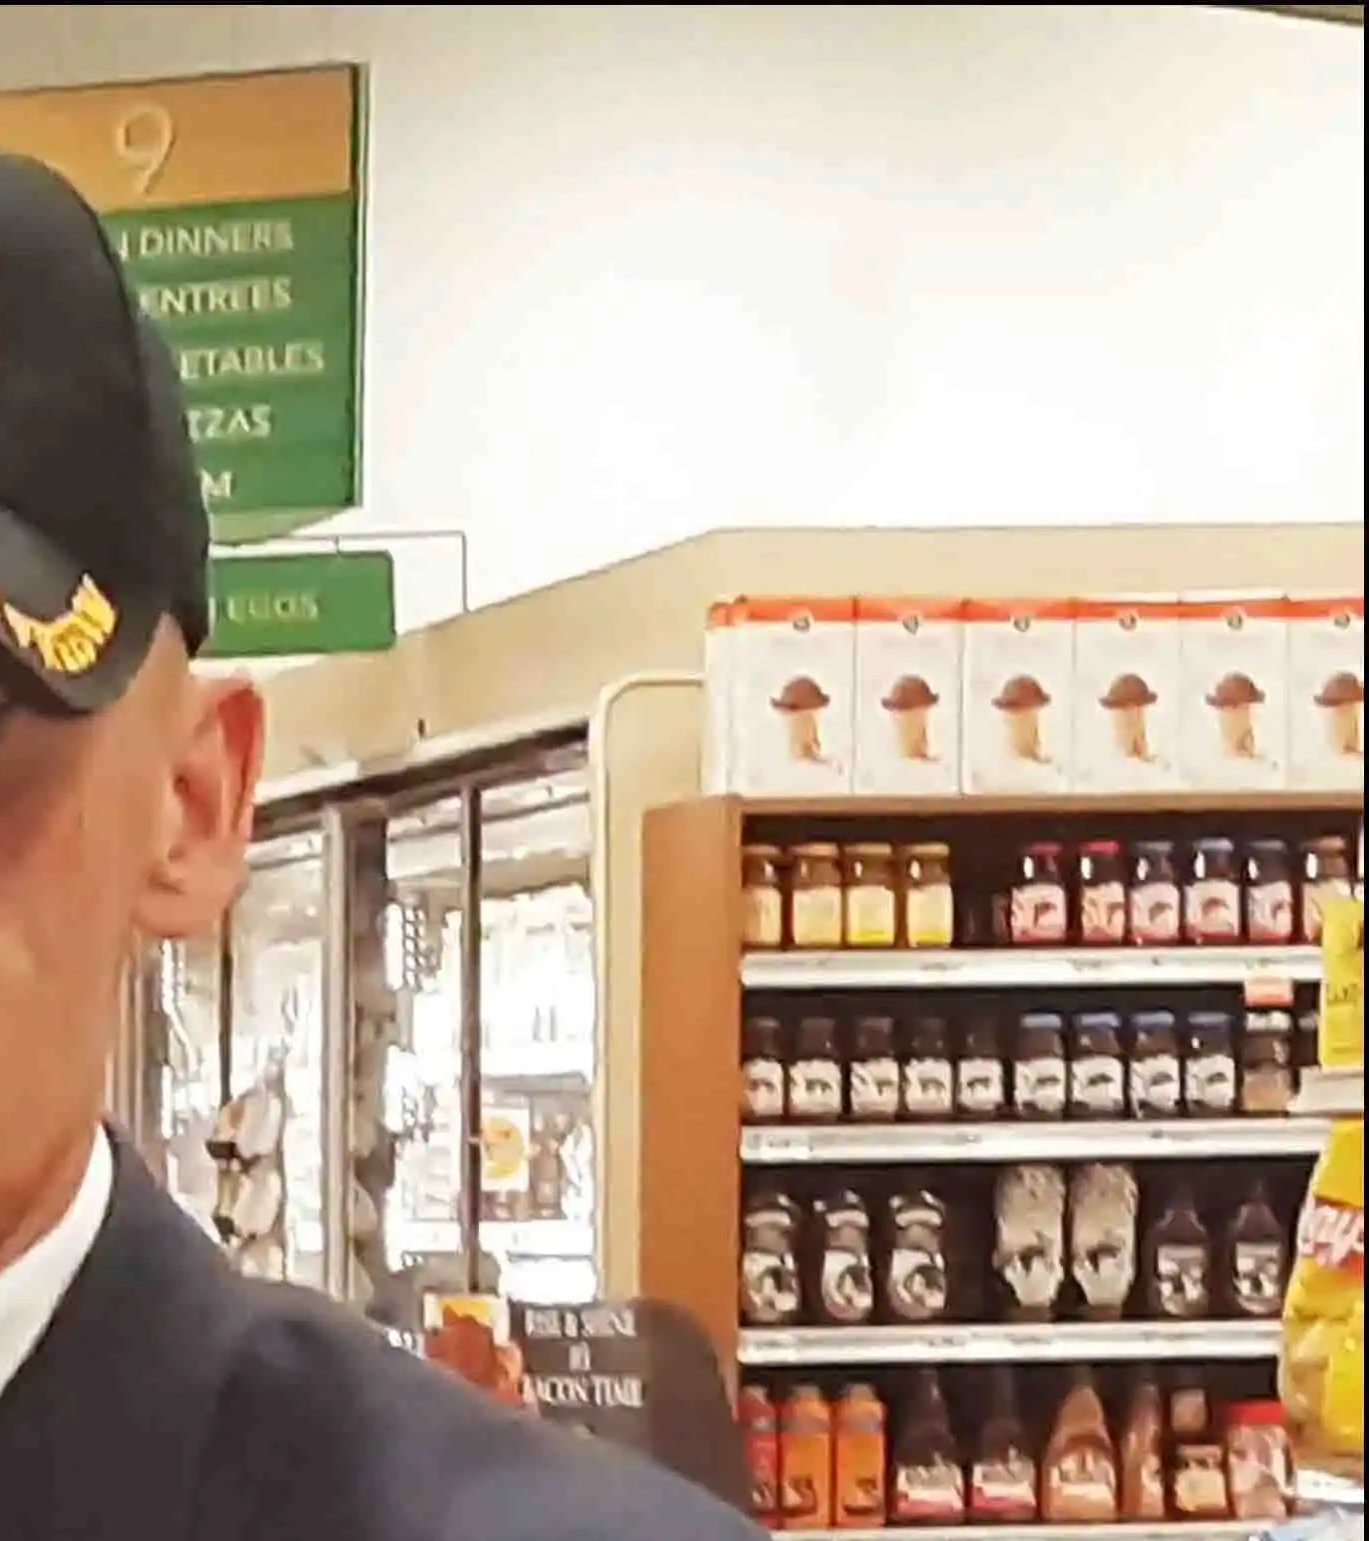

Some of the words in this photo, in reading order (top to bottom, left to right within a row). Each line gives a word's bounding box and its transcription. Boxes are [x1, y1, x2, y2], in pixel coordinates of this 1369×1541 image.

[115, 104, 178, 196] 9
[139, 219, 294, 257] DINNERS
[179, 341, 325, 381] ETABLES
